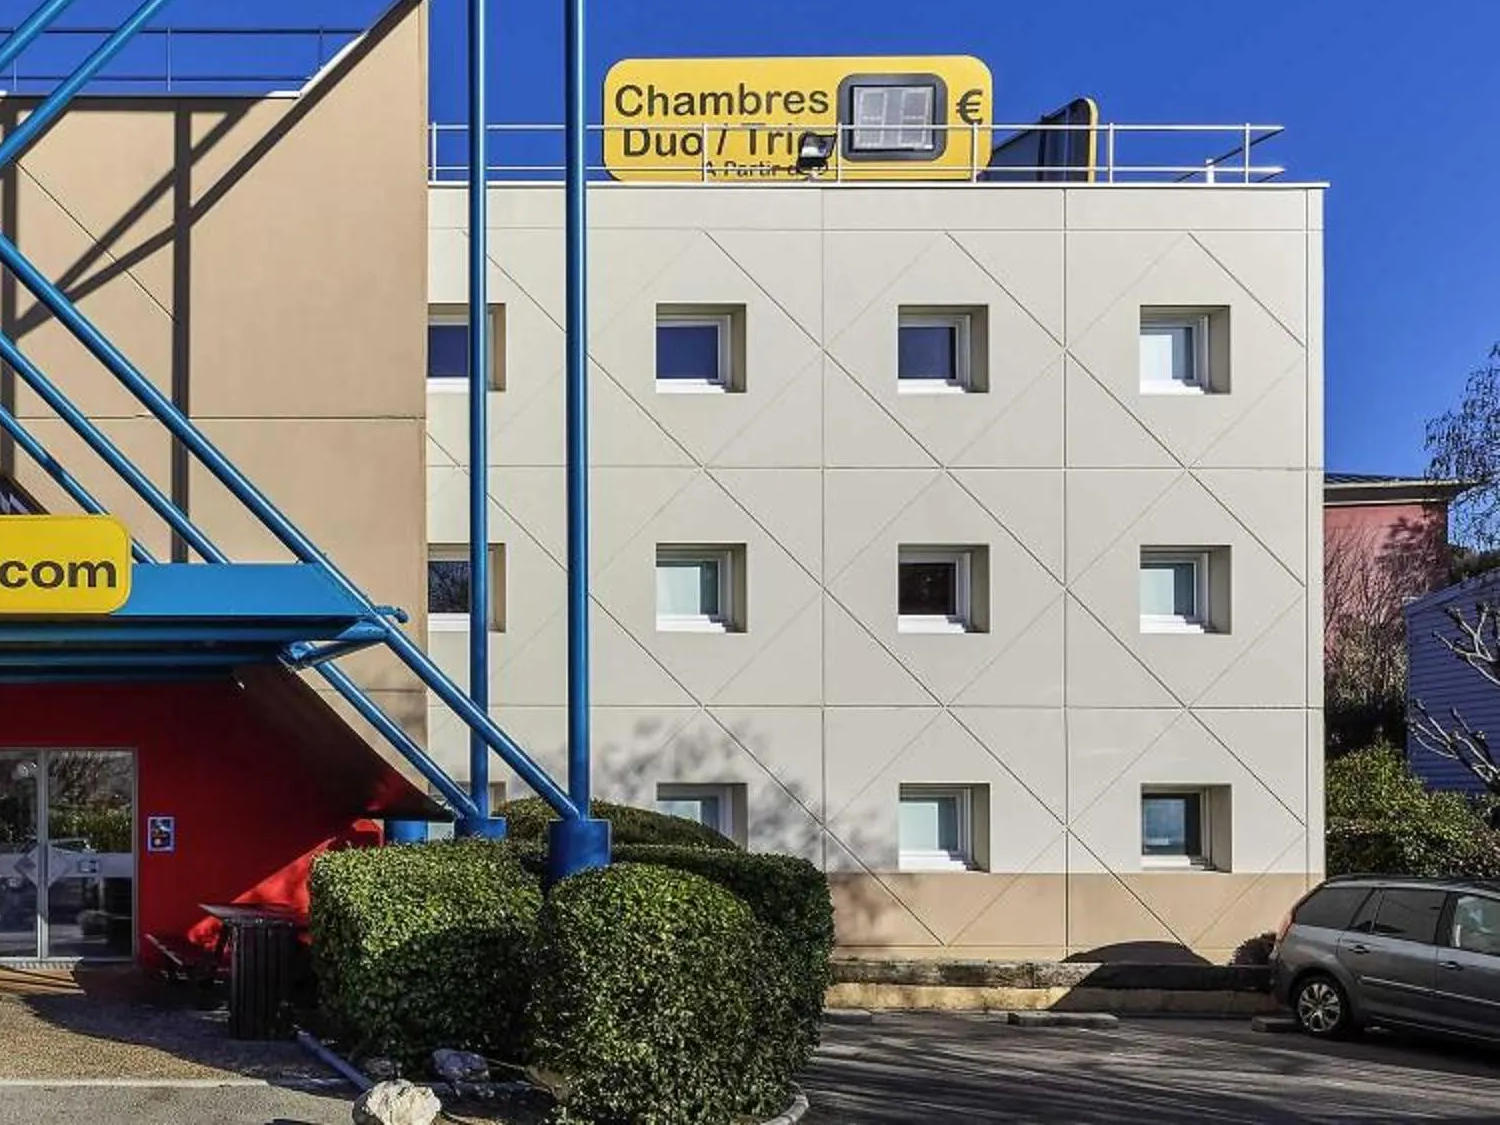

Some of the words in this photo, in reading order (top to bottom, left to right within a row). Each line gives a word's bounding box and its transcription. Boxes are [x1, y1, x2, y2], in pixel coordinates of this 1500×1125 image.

[615, 83, 829, 117] Chambres
[622, 123, 704, 156] Duo
[740, 122, 804, 156] Tri
